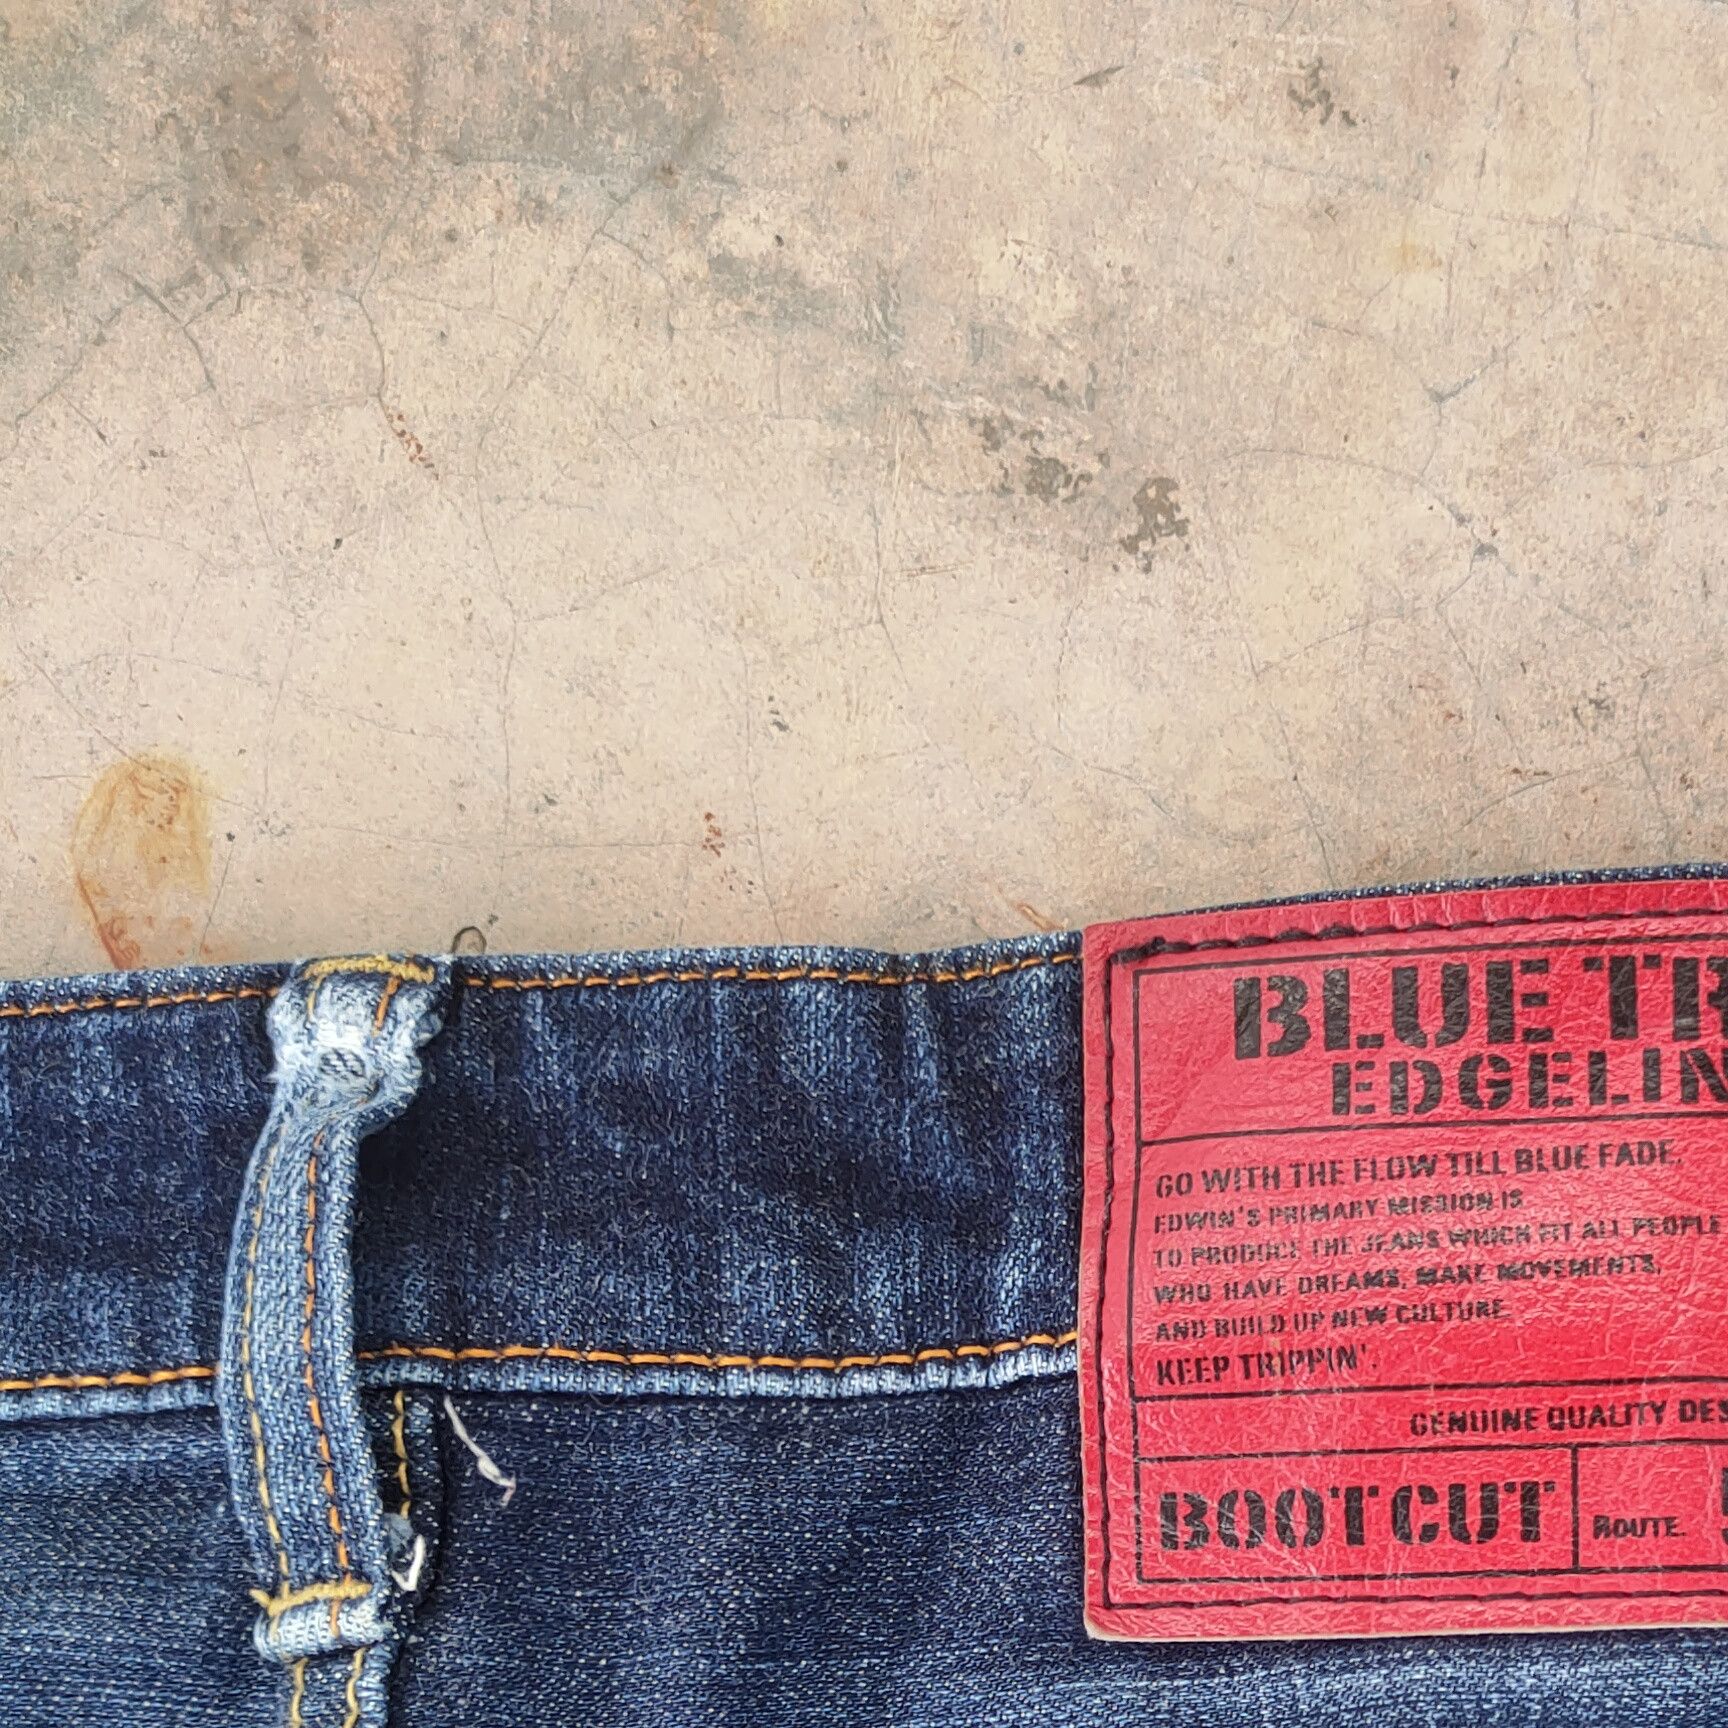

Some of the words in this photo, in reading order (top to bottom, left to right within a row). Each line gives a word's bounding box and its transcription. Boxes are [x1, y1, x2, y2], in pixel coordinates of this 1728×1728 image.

[1233, 958, 1554, 1060] BLUE
[1155, 1171, 1193, 1199] GO
[1201, 1165, 1281, 1193] WITH
[1289, 1160, 1345, 1189] THE
[1353, 1154, 1438, 1183] FLOW
[1448, 1150, 1507, 1178] TILL
[1514, 1144, 1590, 1174] BLUE
[1599, 1139, 1682, 1168] FADE.
[1154, 1206, 1261, 1234] EDWIN'S
[1269, 1199, 1379, 1225] PRIMARY
[1388, 1193, 1493, 1215] MISSION
[1502, 1189, 1523, 1209] IS
[1154, 1249, 1182, 1268] TO
[1191, 1240, 1300, 1266] PRODUCE
[1312, 1237, 1352, 1257] THE
[1361, 1230, 1440, 1253] JEANS
[1449, 1224, 1531, 1247] WHICH
[1539, 1222, 1572, 1243] FIT
[1582, 1219, 1619, 1240] ALL
[1632, 1214, 1722, 1237] PEOPLE
[1154, 1283, 1211, 1303] WHO
[1222, 1277, 1286, 1301] HAVE
[1416, 1263, 1484, 1287] MAKE
[1156, 1318, 1207, 1342] AND
[1215, 1314, 1285, 1338] BUILD
[1294, 1311, 1325, 1332] UP
[1331, 1305, 1388, 1329] NEW
[1156, 1355, 1230, 1386] KEEP
[1410, 1404, 1537, 1437] GENUINE
[1548, 1401, 1666, 1431] QUALITY
